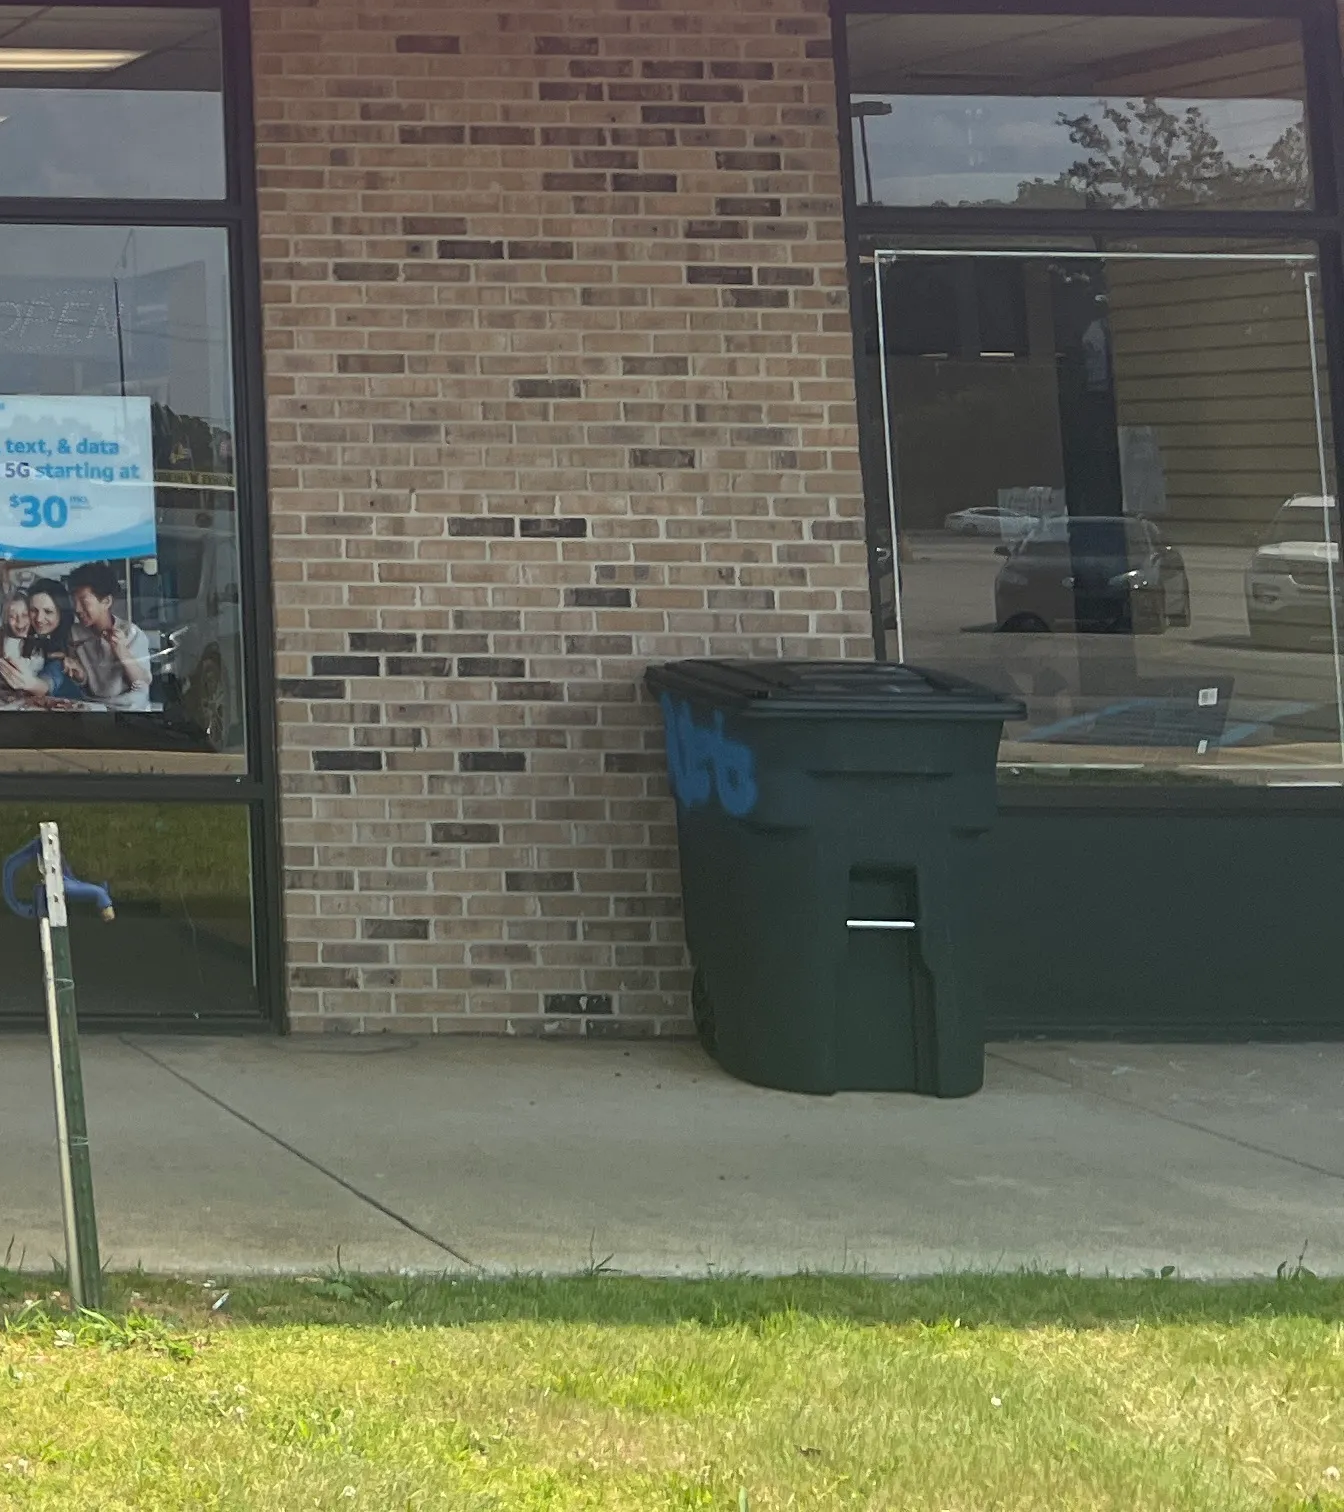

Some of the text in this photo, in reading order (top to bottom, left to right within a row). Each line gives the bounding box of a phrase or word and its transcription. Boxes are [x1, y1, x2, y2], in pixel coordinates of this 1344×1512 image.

[5, 438, 52, 457] text,
[57, 438, 71, 454] &
[76, 438, 120, 454] data
[5, 461, 31, 479] 5G
[35, 462, 114, 482] starting
[119, 464, 140, 479] at
[9, 494, 68, 529] $30
